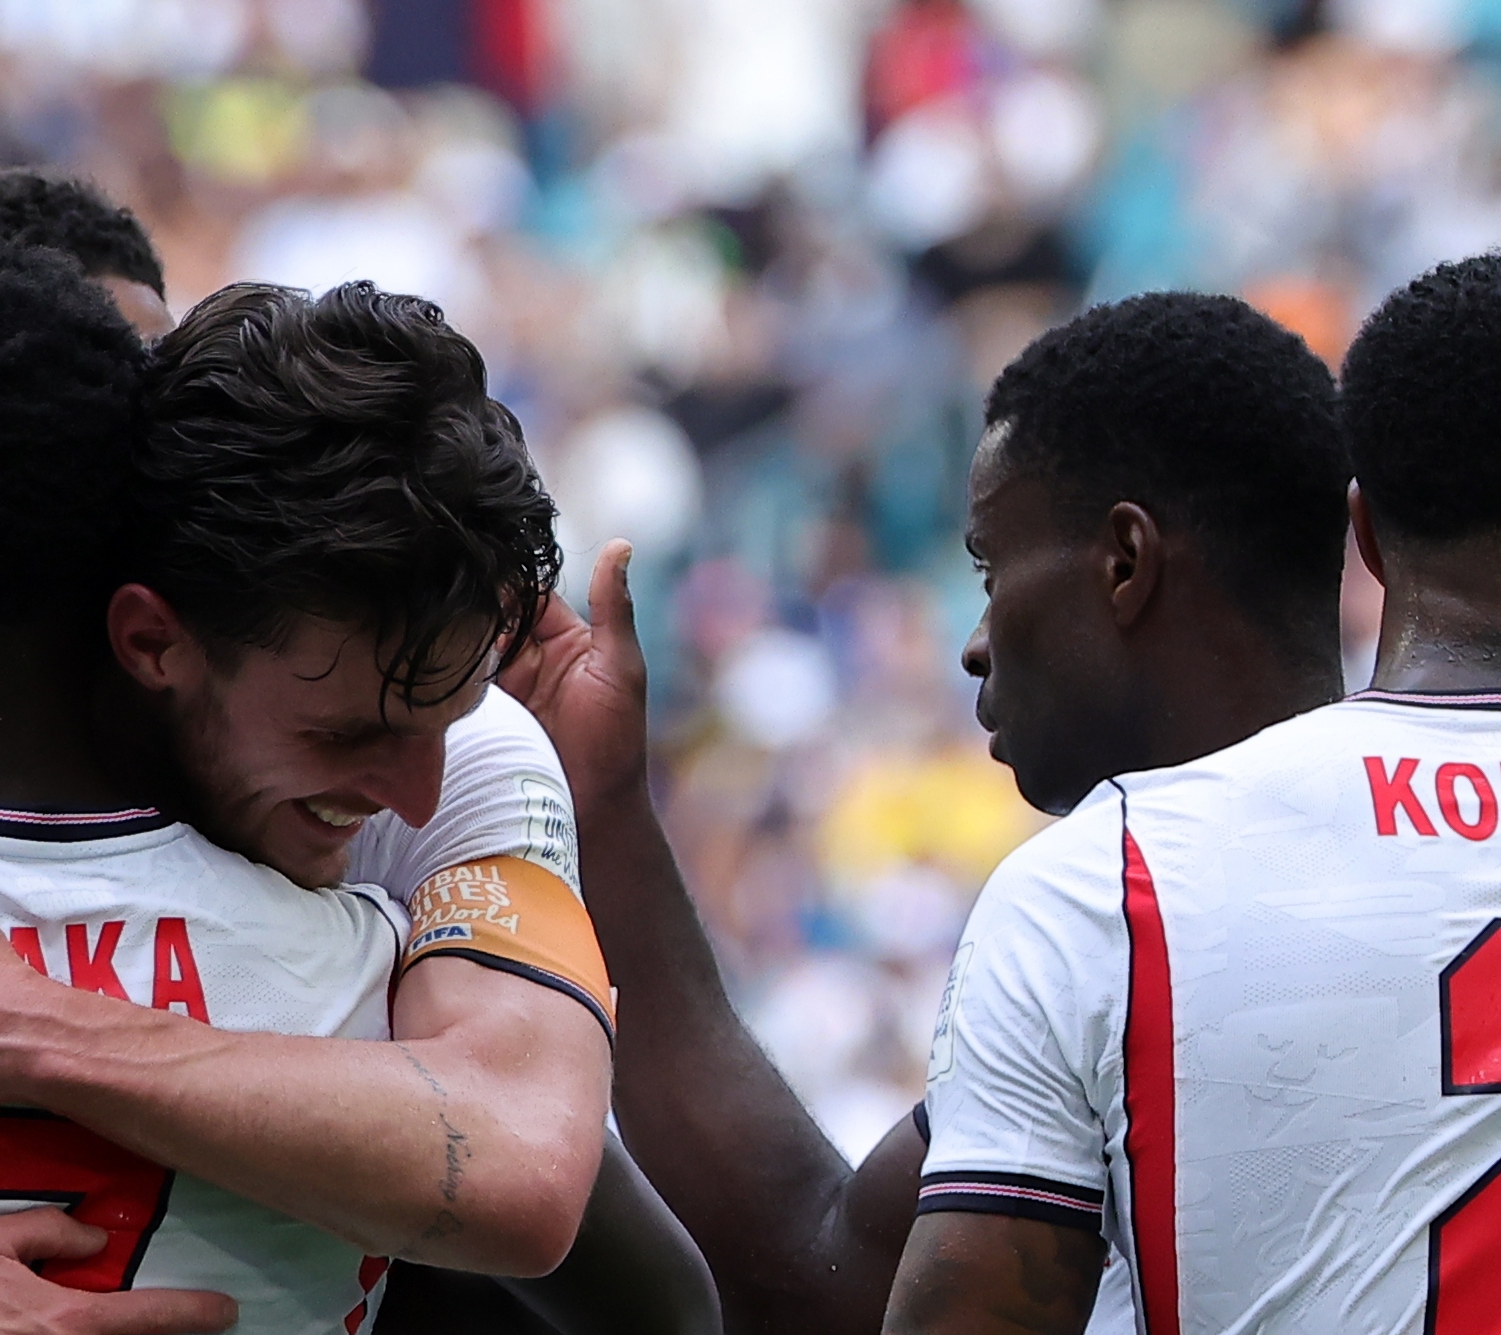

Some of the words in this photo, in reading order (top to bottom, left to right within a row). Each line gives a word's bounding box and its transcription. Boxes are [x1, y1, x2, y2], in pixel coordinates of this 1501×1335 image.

[412, 881, 512, 921] ITES
[419, 904, 520, 935] World
[412, 924, 468, 951] FIFA
[5, 916, 211, 1026] AKA
